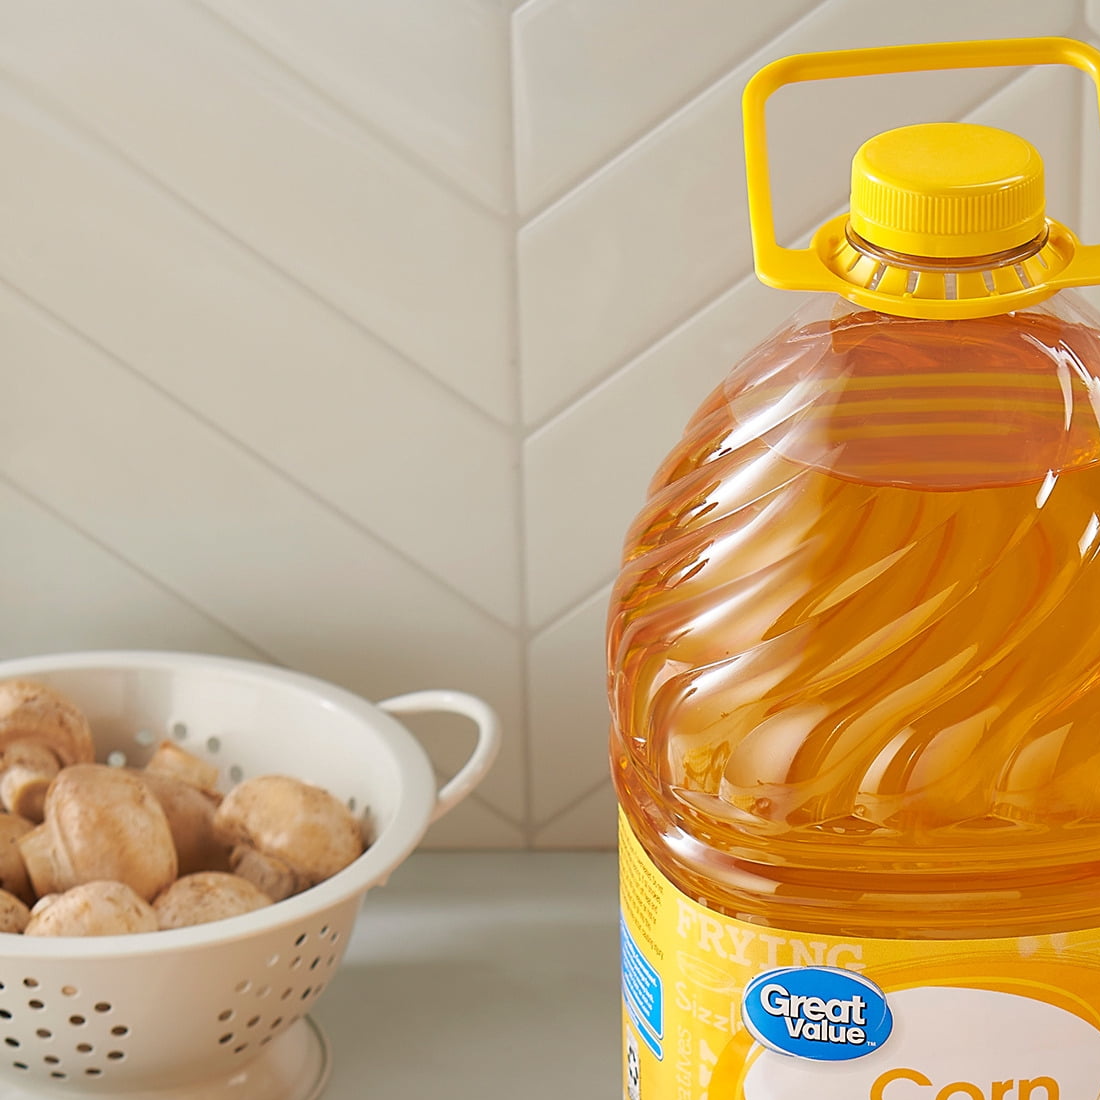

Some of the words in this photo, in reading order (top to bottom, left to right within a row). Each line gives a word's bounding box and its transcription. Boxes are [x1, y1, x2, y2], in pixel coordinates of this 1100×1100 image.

[677, 899, 866, 970] FRYING
[675, 982, 744, 1035] Sizzl
[760, 983, 867, 1026] Great
[783, 1015, 867, 1045] Value
